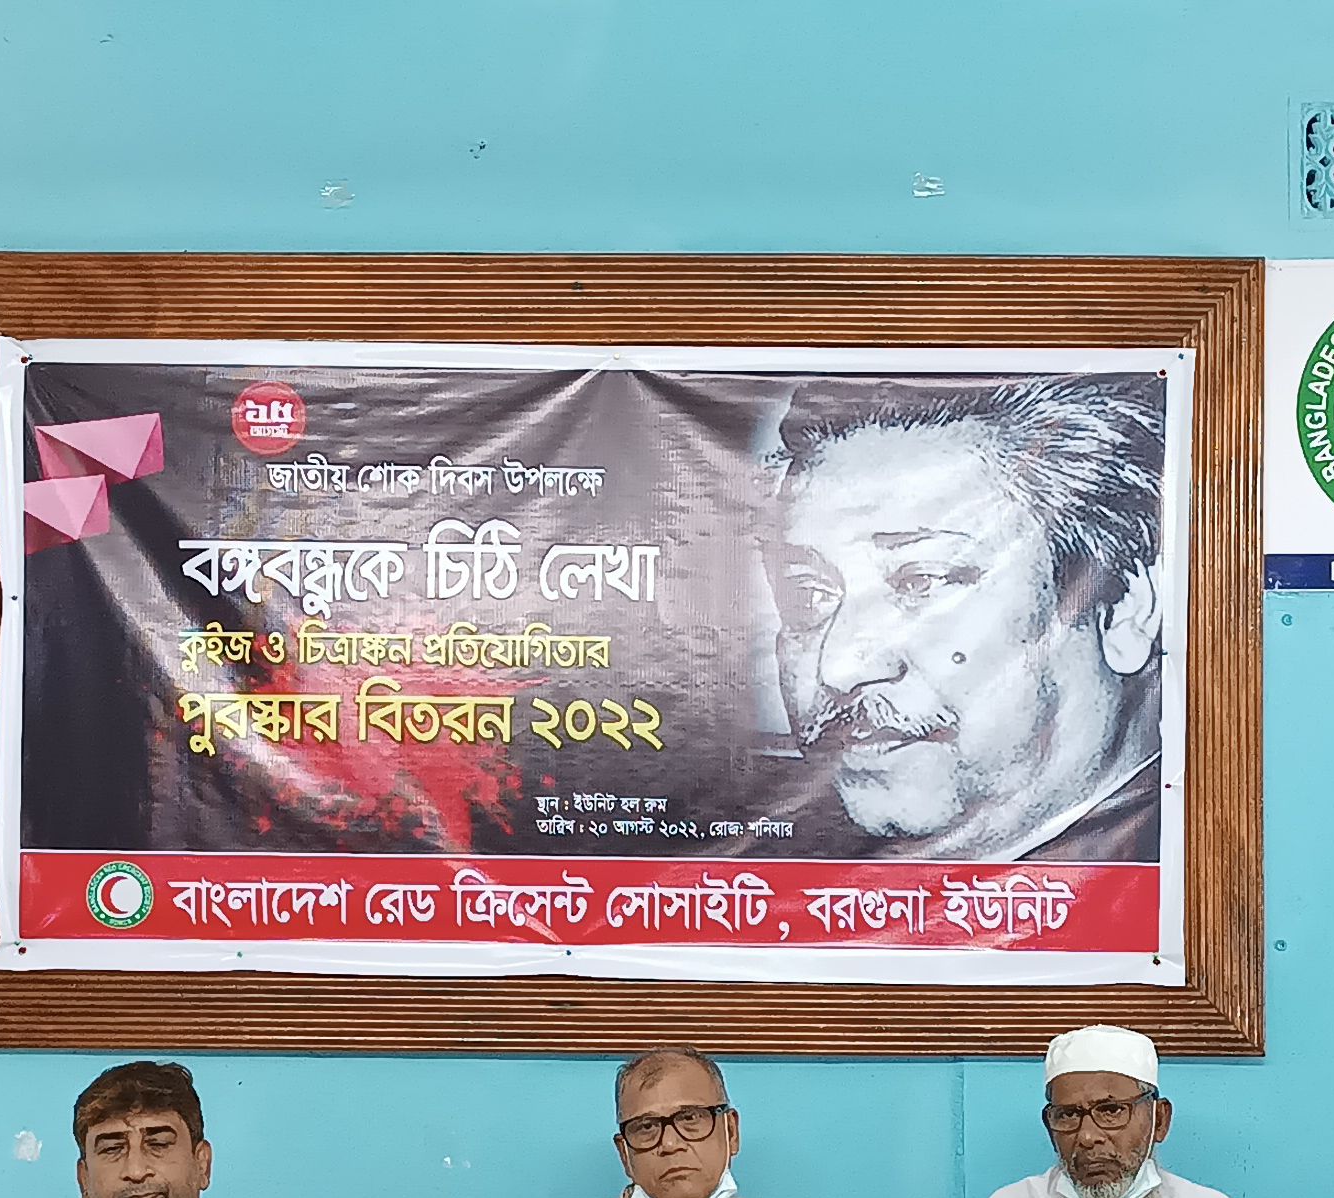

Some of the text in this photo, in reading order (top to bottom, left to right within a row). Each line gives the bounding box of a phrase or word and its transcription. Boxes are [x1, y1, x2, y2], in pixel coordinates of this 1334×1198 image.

[266, 453, 606, 497] জাতীয় শোক দিবস উপলক্ষে
[179, 516, 661, 620] বঙ্গবন্ধুকে চিঠি লেখা
[178, 619, 612, 671] কুইজ ও চিত্রাঙ্কন প্রতিযোগিতার
[178, 676, 664, 757] পুরস্কার বিতরন ২০২২
[572, 792, 618, 813] ইউনিট
[620, 797, 641, 814] হল
[643, 798, 668, 814] রুম
[588, 820, 608, 838] ২০
[613, 816, 656, 836] আগস্ট
[746, 816, 794, 839] শনিবার
[167, 878, 355, 929] বাংলাদেশ
[365, 883, 441, 928] রেড
[449, 868, 595, 929] ক্রিসেন্ট
[805, 885, 933, 936] বরগুনা
[941, 874, 1076, 937] ইউনিট
